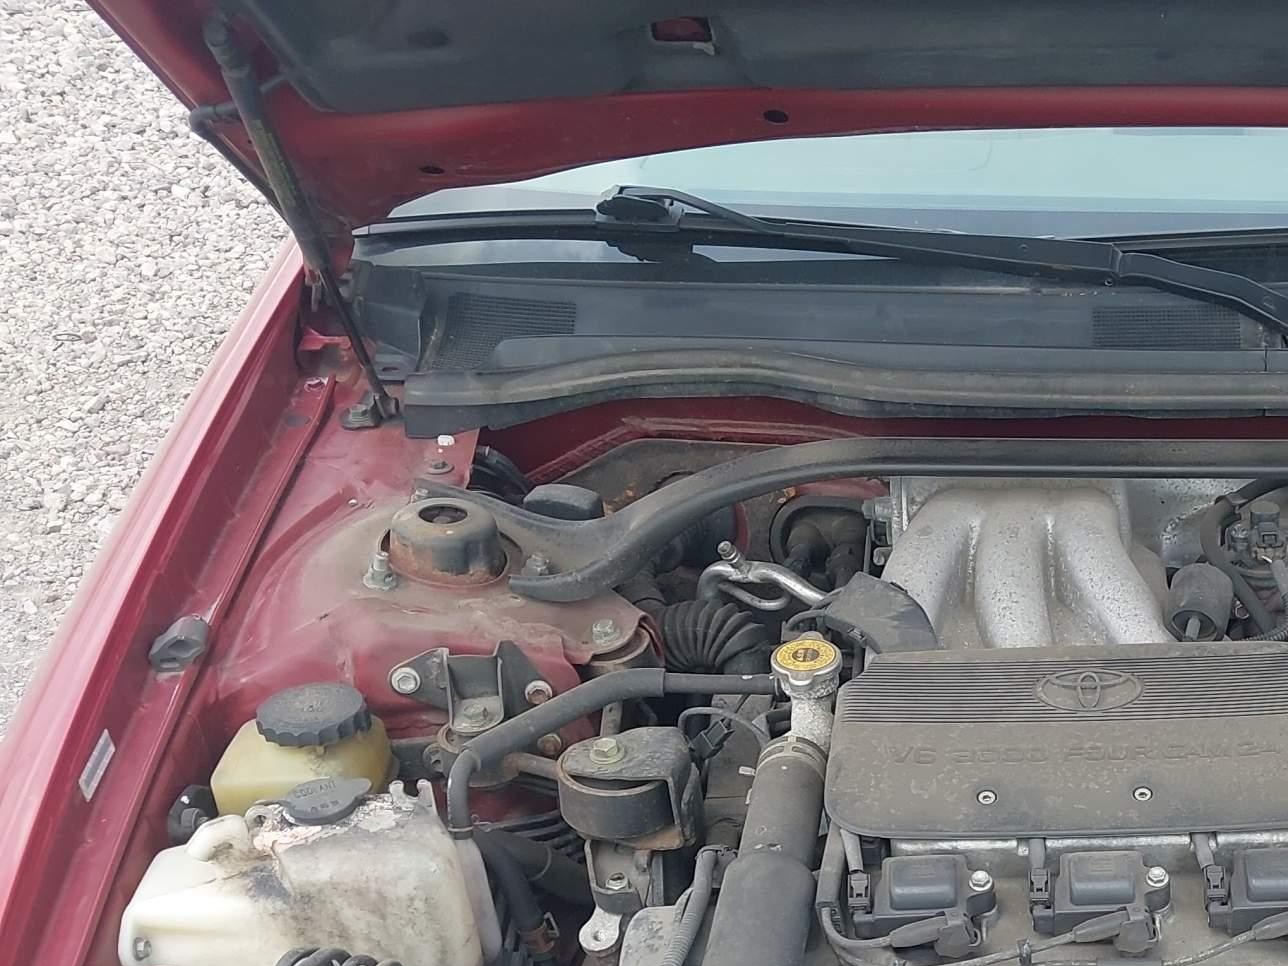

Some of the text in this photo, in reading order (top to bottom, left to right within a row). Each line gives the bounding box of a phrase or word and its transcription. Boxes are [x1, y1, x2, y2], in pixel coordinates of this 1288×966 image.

[890, 746, 936, 765] V6
[949, 747, 1048, 765] 3000
[1064, 745, 1154, 763] FOUR
[1160, 744, 1230, 762] CAM
